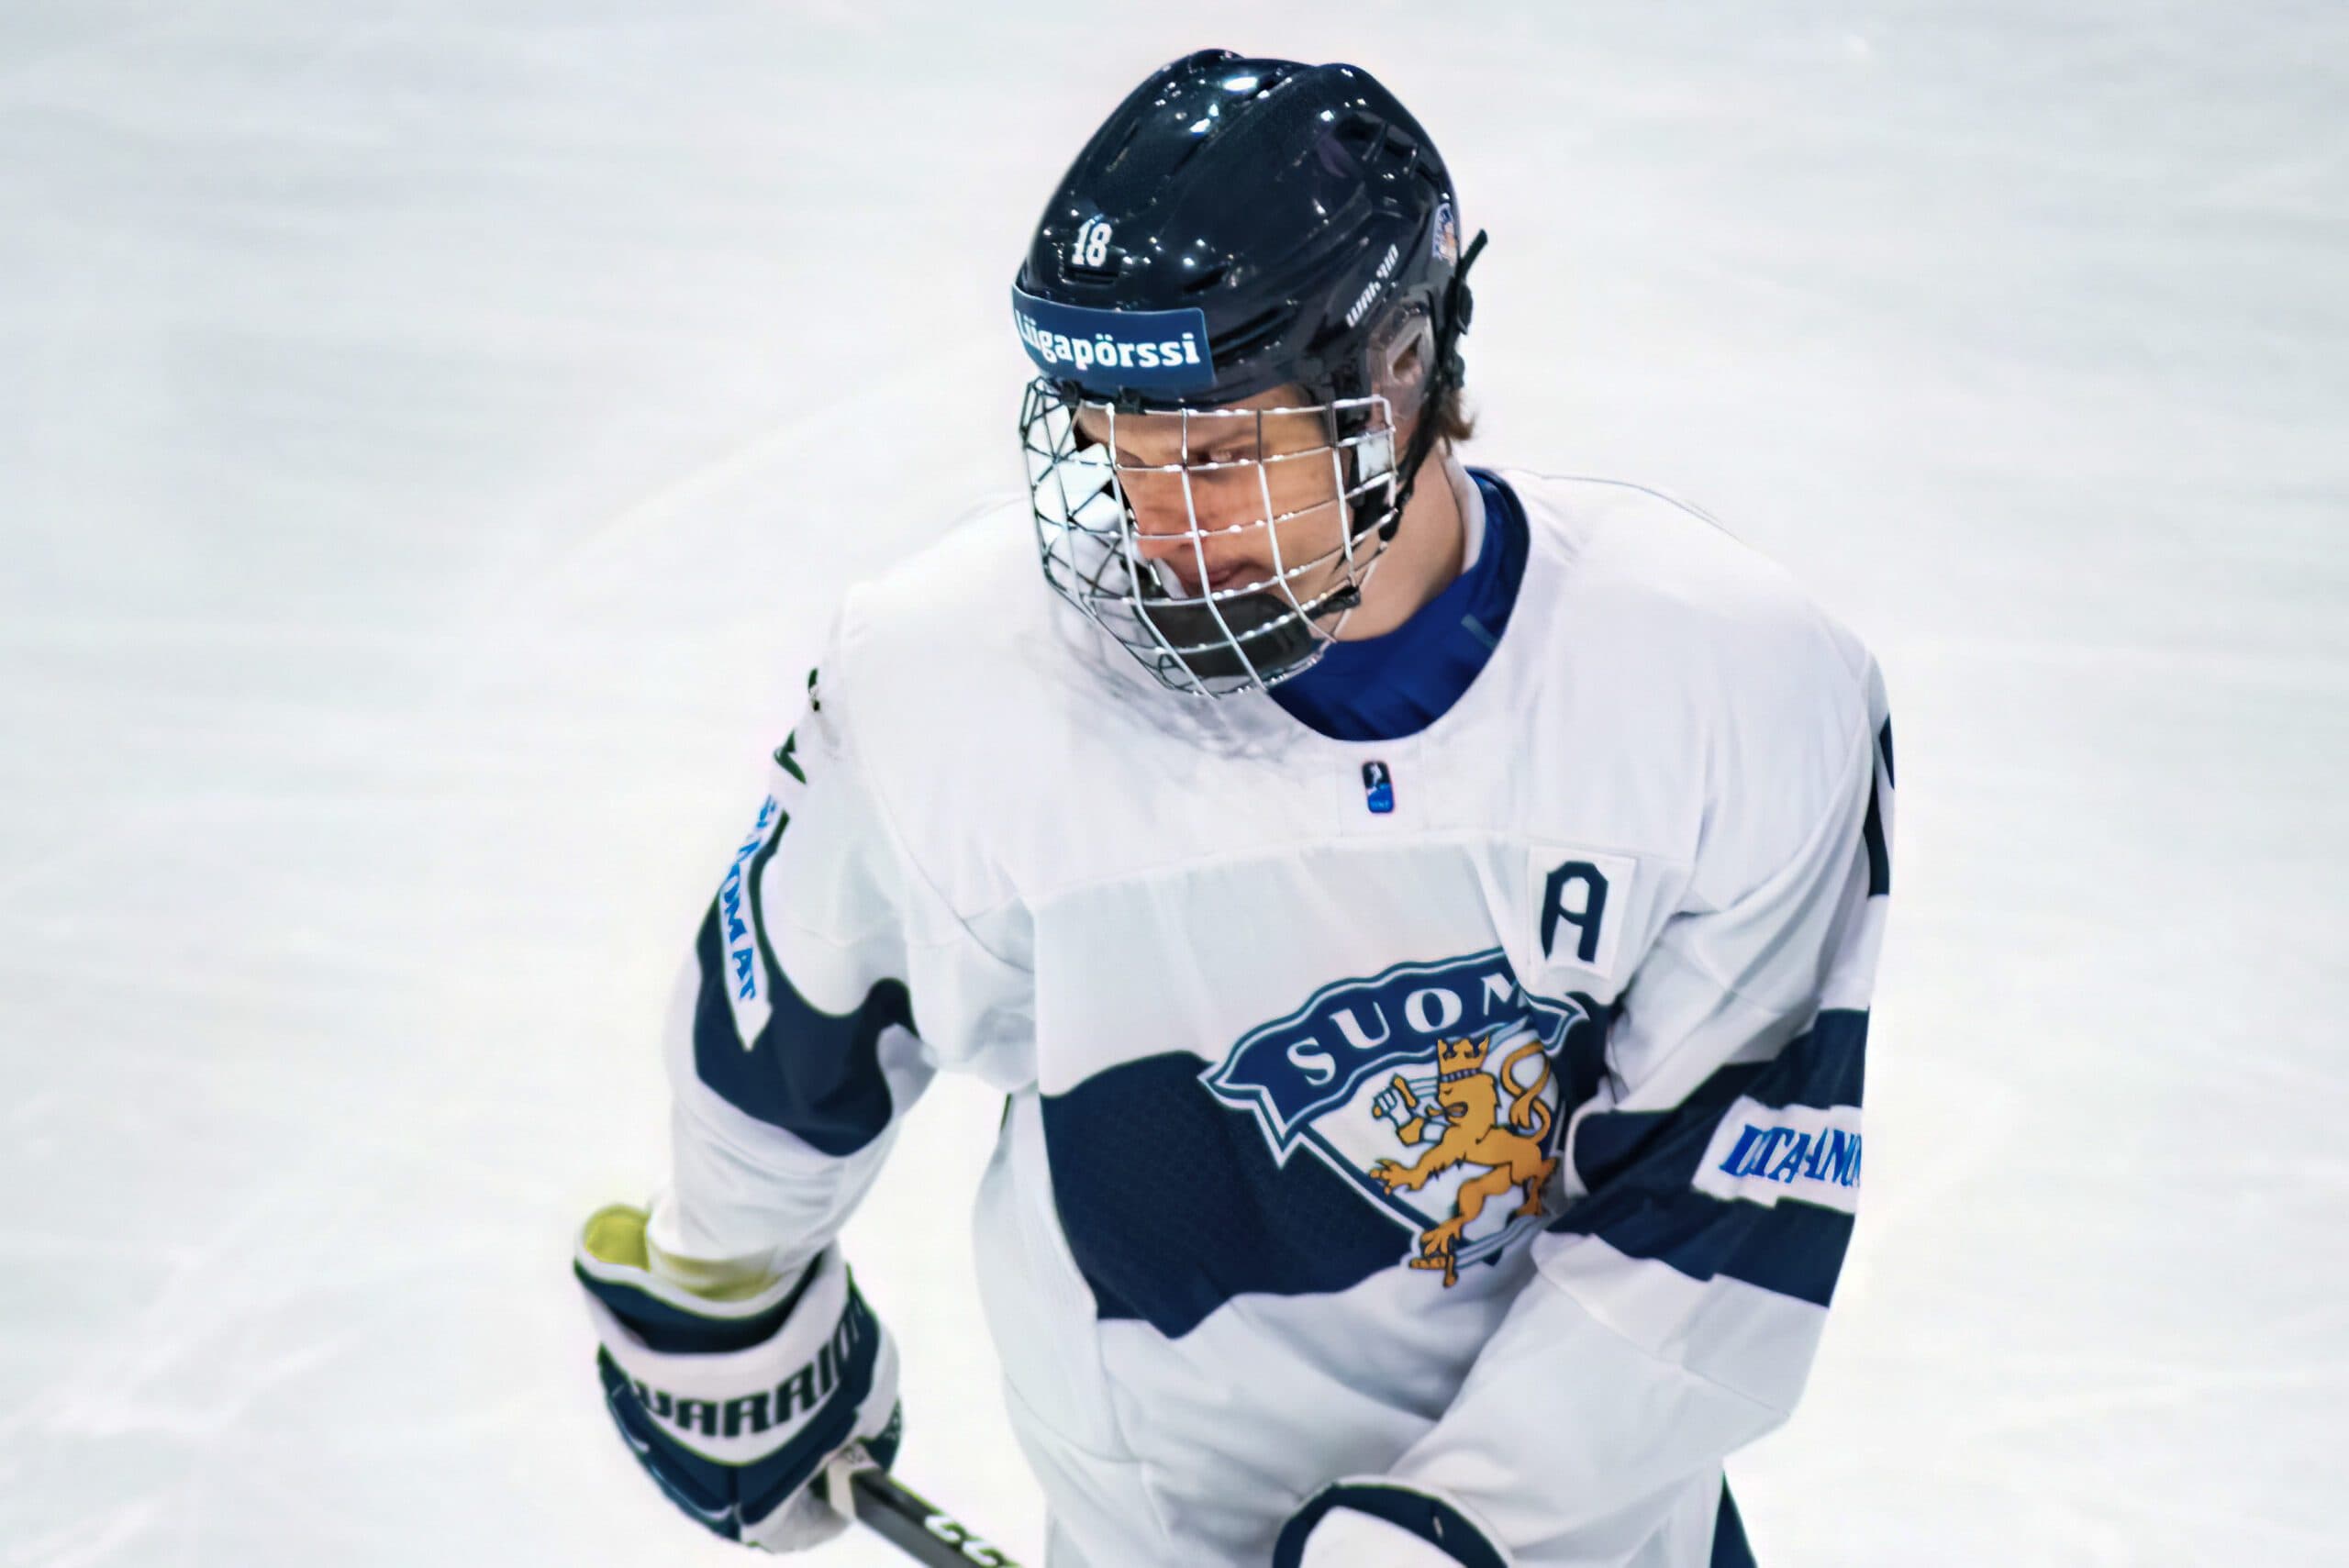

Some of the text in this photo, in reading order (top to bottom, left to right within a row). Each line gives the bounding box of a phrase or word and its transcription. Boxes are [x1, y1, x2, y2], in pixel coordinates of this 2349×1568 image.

[1072, 218, 1112, 267] 18
[1015, 308, 1200, 371] Liigapörssi
[1540, 861, 1609, 963] A
[1286, 972, 1523, 1087] SUOM
